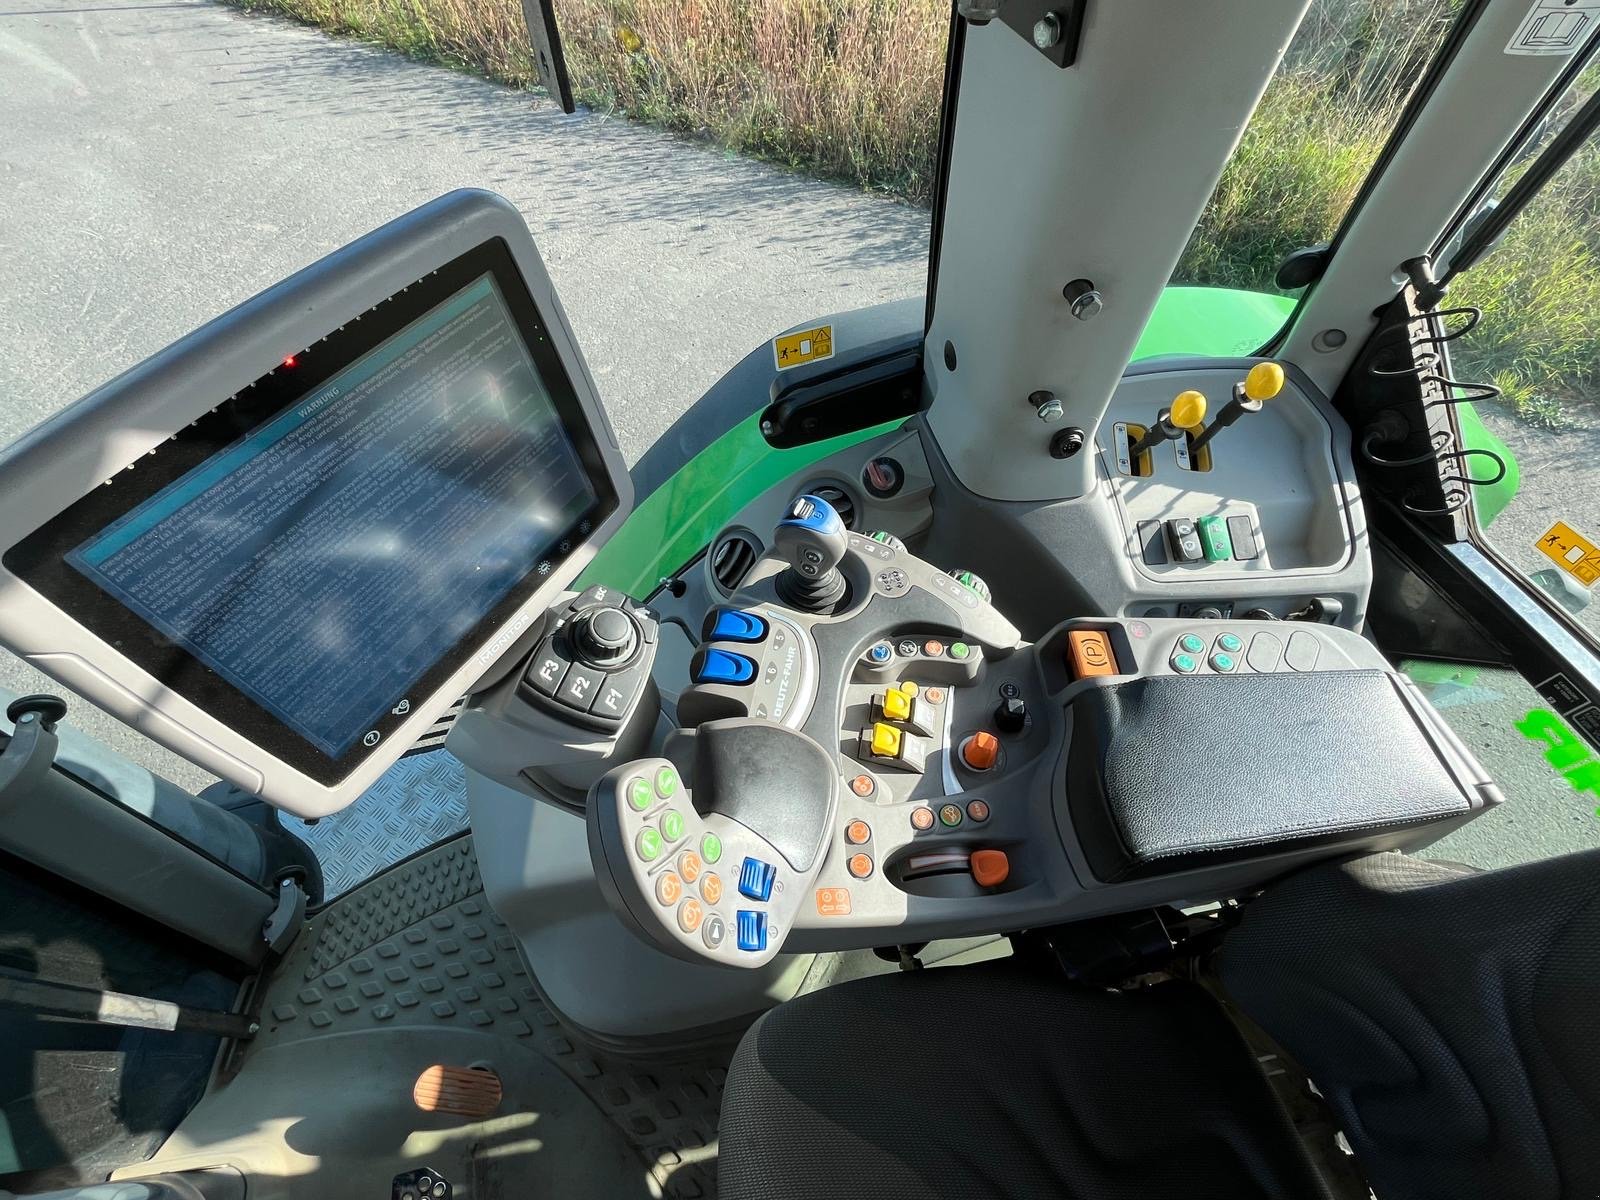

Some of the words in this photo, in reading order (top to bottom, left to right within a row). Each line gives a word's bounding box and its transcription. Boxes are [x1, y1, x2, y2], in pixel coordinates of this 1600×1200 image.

[297, 386, 340, 419] WARNUNG
[539, 659, 560, 681] F3
[774, 646, 797, 717] DEUTZ-FAHR
[570, 676, 591, 699] F2
[604, 687, 624, 711] F1
